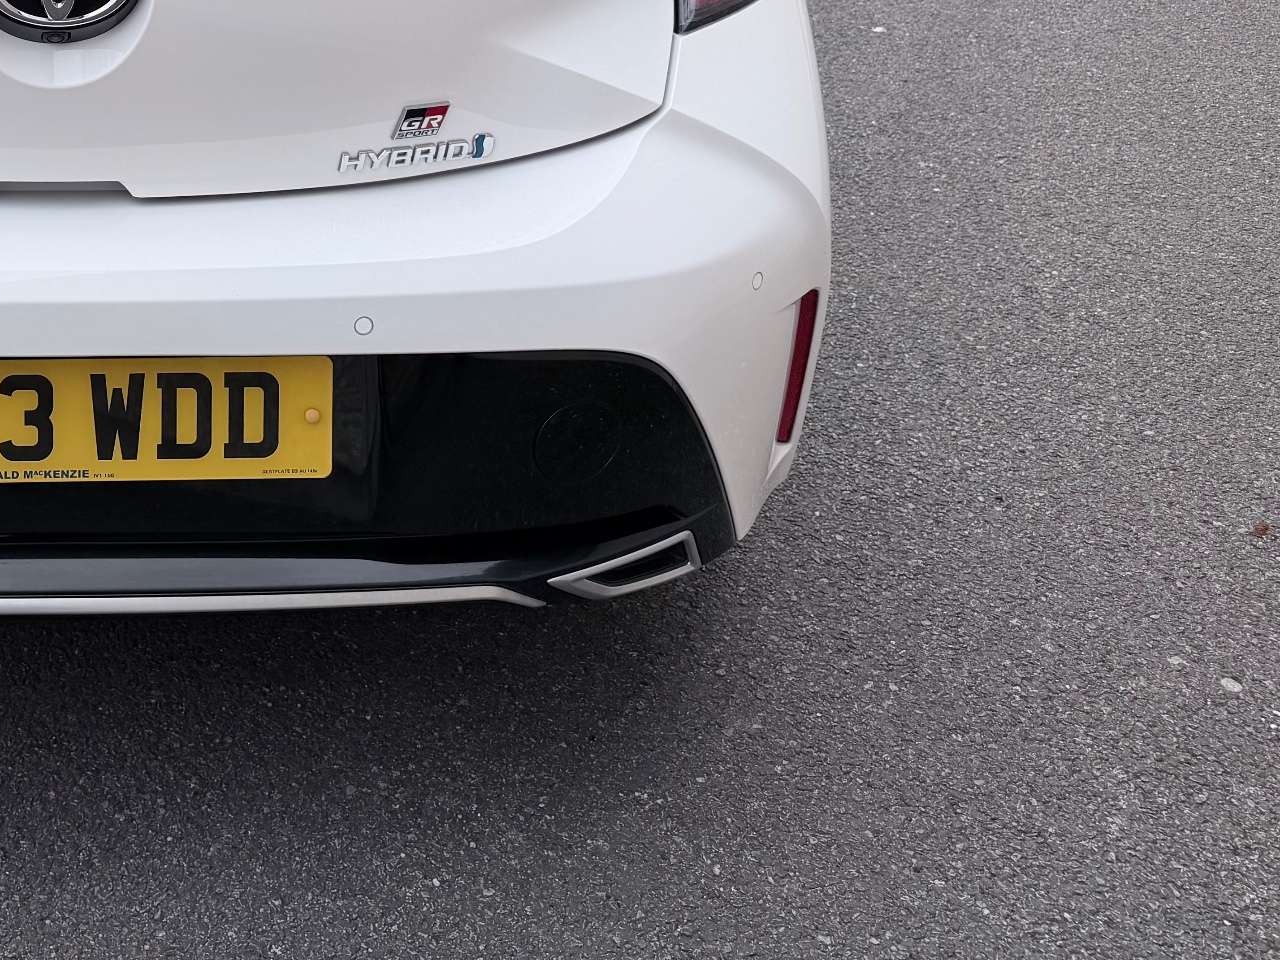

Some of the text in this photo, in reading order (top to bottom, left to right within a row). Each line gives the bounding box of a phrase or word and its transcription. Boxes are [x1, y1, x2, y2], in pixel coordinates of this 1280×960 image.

[397, 128, 440, 138] SPORT
[400, 114, 444, 131] GR
[338, 141, 470, 173] HYBRID
[90, 371, 280, 460] WDD
